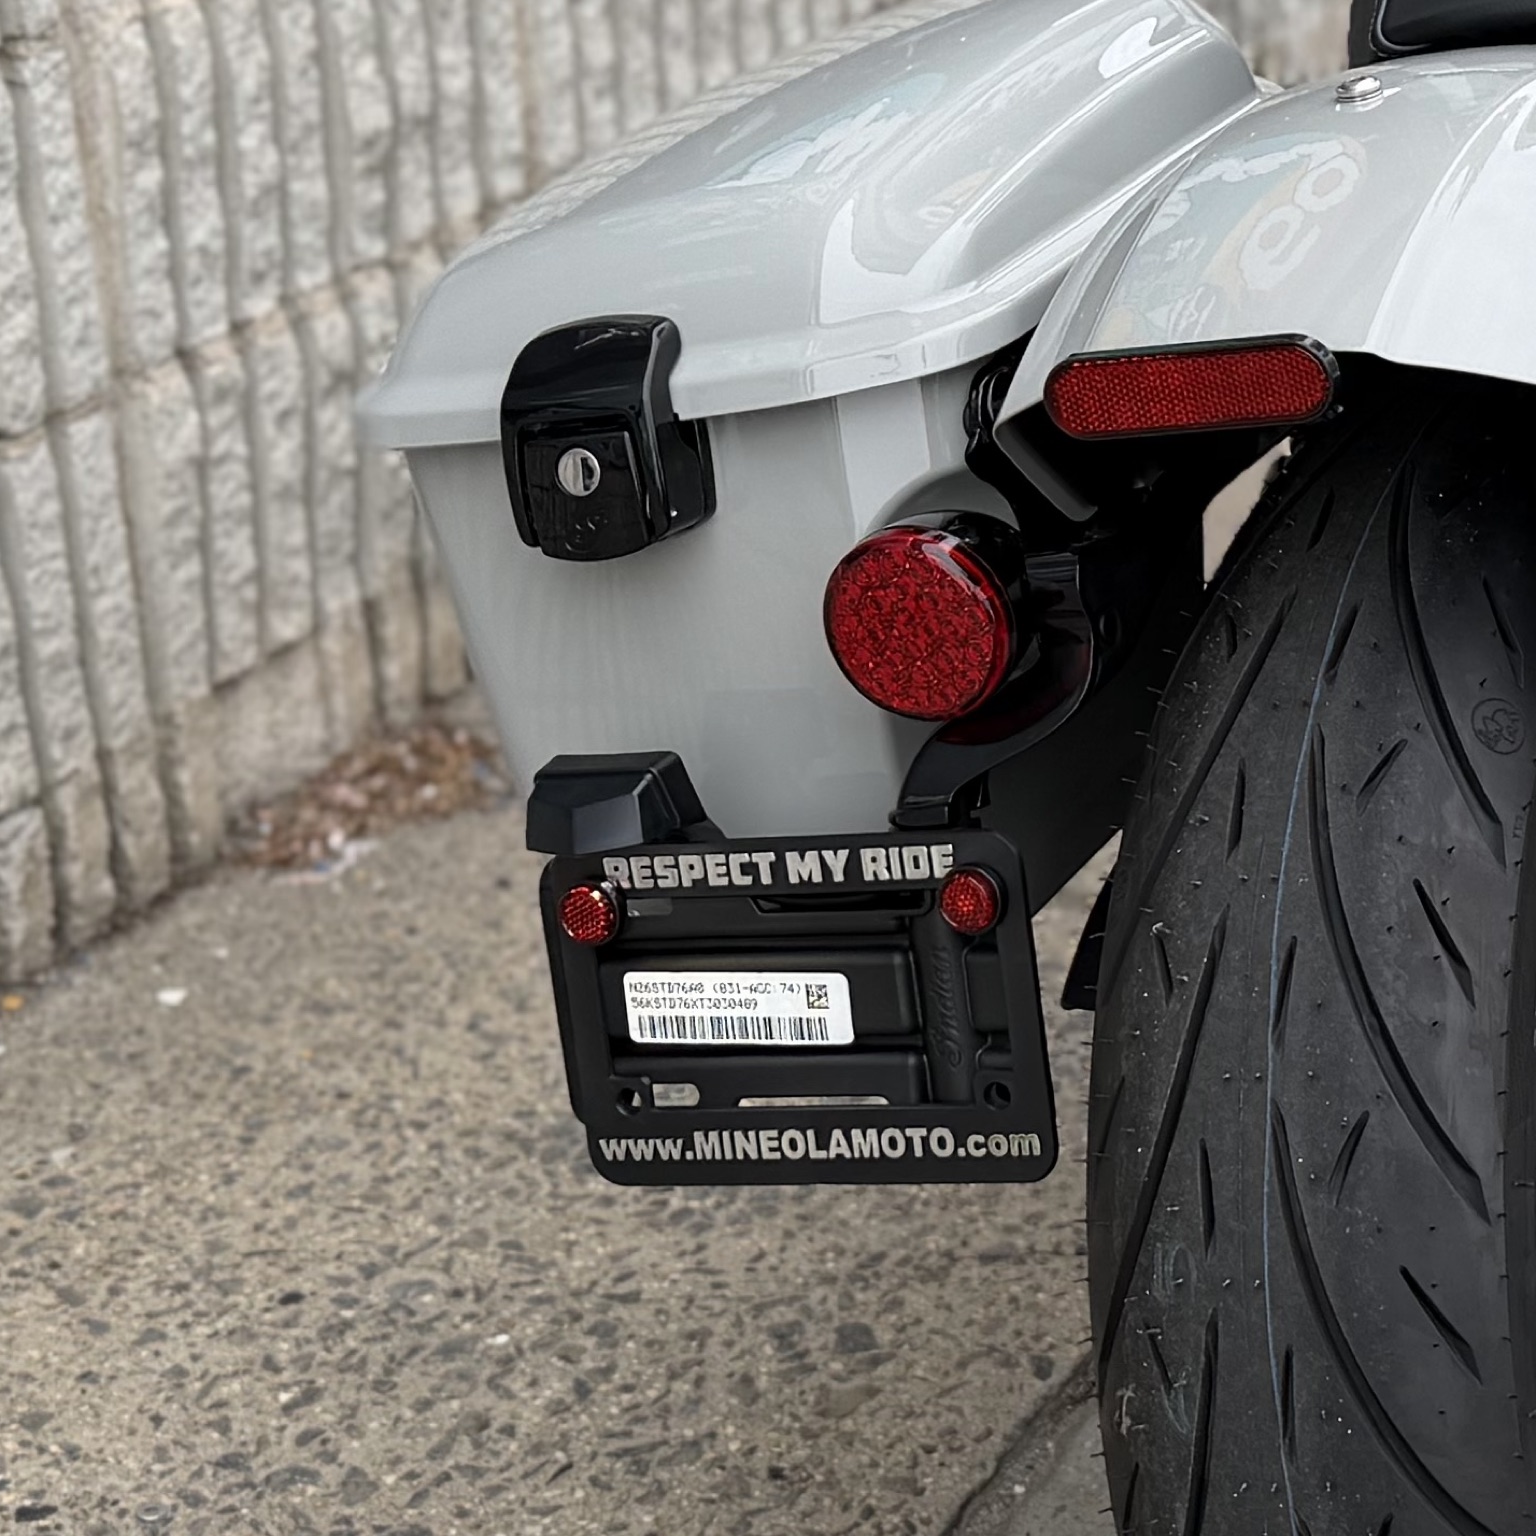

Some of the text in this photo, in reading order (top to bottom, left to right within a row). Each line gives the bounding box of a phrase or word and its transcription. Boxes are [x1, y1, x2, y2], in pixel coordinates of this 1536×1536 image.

[602, 843, 954, 890] RESPECT MY RIDE
[598, 1126, 1041, 1163] www.MINEOLAMOTO.com
